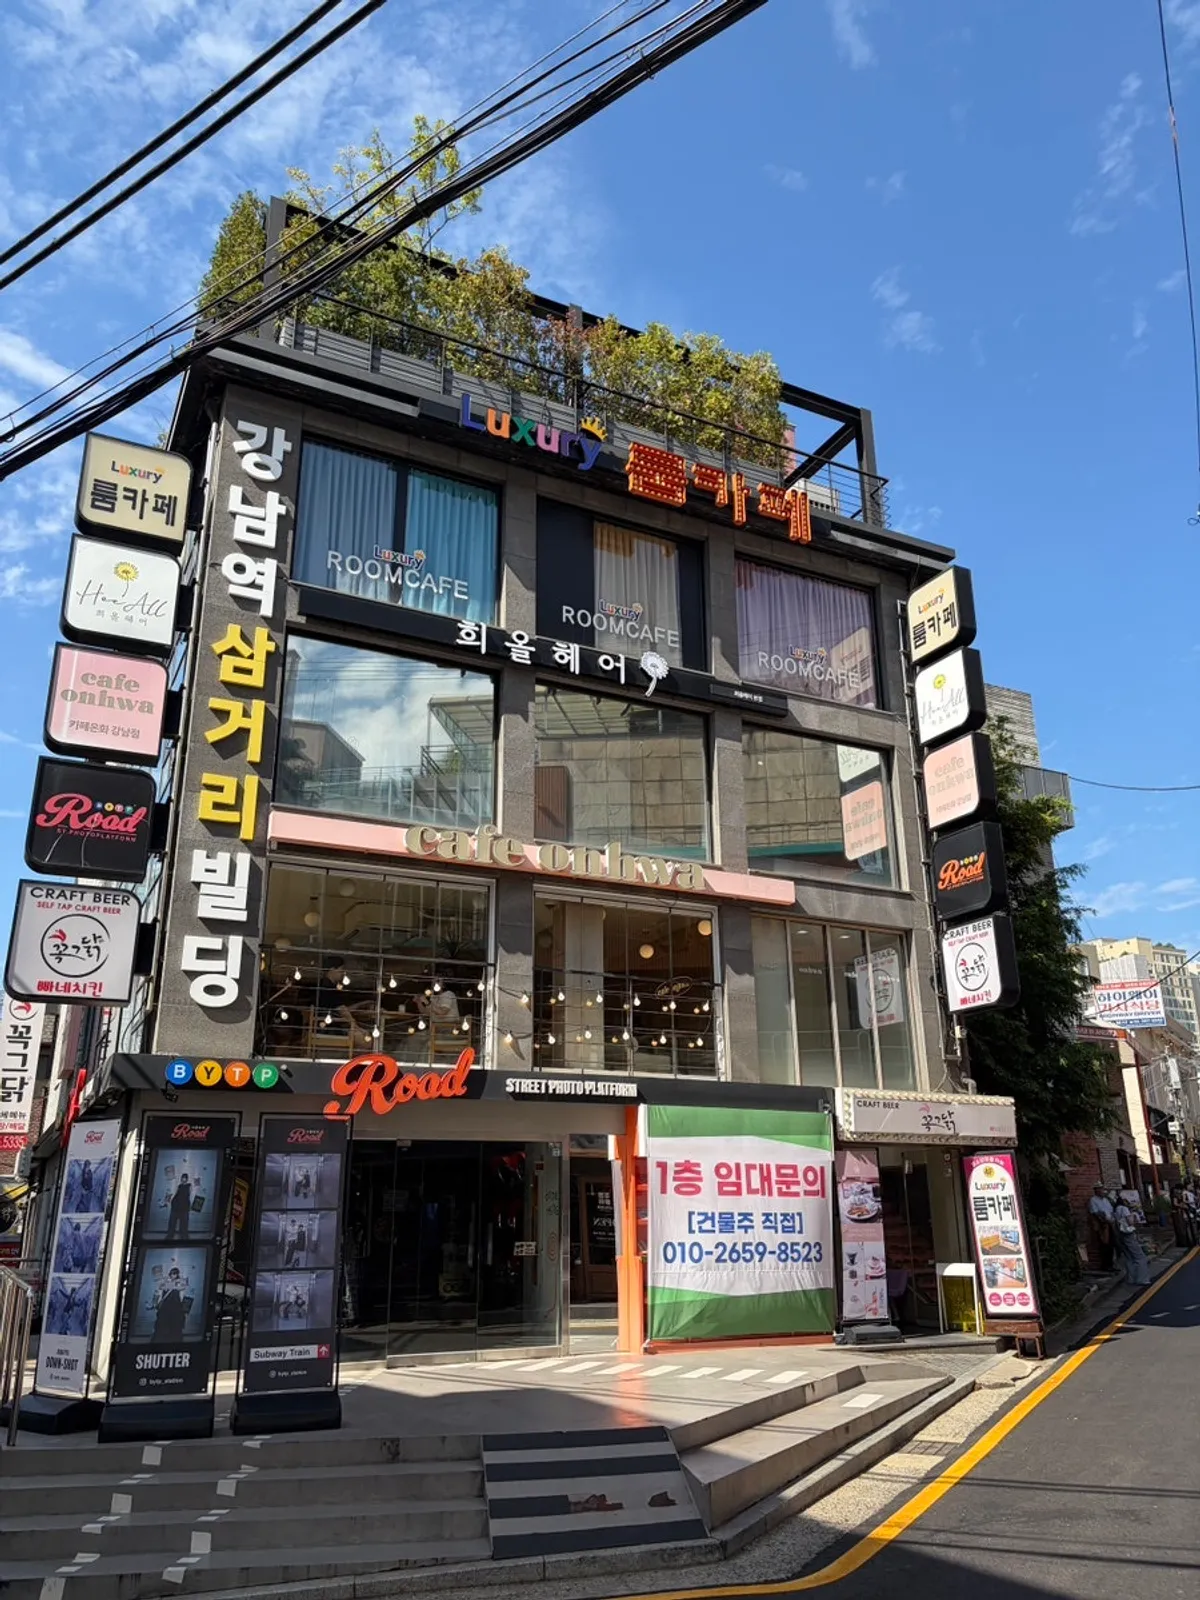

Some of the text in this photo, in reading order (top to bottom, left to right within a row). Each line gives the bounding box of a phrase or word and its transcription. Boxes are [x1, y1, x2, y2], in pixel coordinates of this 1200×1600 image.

[461, 393, 601, 471] Luxury
[111, 460, 163, 483] Luxury
[90, 478, 178, 527] 룸카페
[625, 441, 813, 545] 룸카페
[373, 545, 424, 569] Luxury
[326, 550, 469, 600] ROOMCAFE
[600, 599, 641, 621] Luxury
[562, 605, 679, 648] ROOMCAFE
[912, 601, 957, 650] 룸카페
[789, 644, 827, 666] Luxury
[758, 651, 861, 688] ROOMCAFE
[80, 672, 140, 693] cafe
[60, 688, 155, 715] onhwa
[181, 420, 292, 1007] 강남역 삼거리 빌딩
[935, 757, 965, 778] cafe
[36, 793, 147, 832] Road
[403, 824, 706, 890] cafe onhwa
[938, 852, 986, 889] Road
[30, 886, 131, 906] CRAFT BEER
[57, 903, 72, 911] TAP
[74, 904, 100, 914] CRAFT
[102, 906, 121, 915] BEER
[944, 920, 992, 941] CRAFT BEER
[36, 980, 104, 999] 빠네치킨
[1, 1024, 32, 1103] 꼭그닭
[323, 1047, 475, 1120] Road
[505, 1078, 638, 1097] STREET PHOTO PLATFORM
[857, 1100, 881, 1108] CRAFT
[171, 1123, 211, 1140] Road
[287, 1128, 325, 1144] Road
[656, 1160, 826, 1199] 1층 임대문의
[975, 1181, 1007, 1192] Luxury
[972, 1194, 1018, 1222] 룸카페
[688, 1211, 804, 1235] [건물주 직접]
[663, 1241, 823, 1264] 010-2659-8523
[136, 1352, 190, 1370] SHUTTER
[254, 1348, 311, 1360] Subway Train
